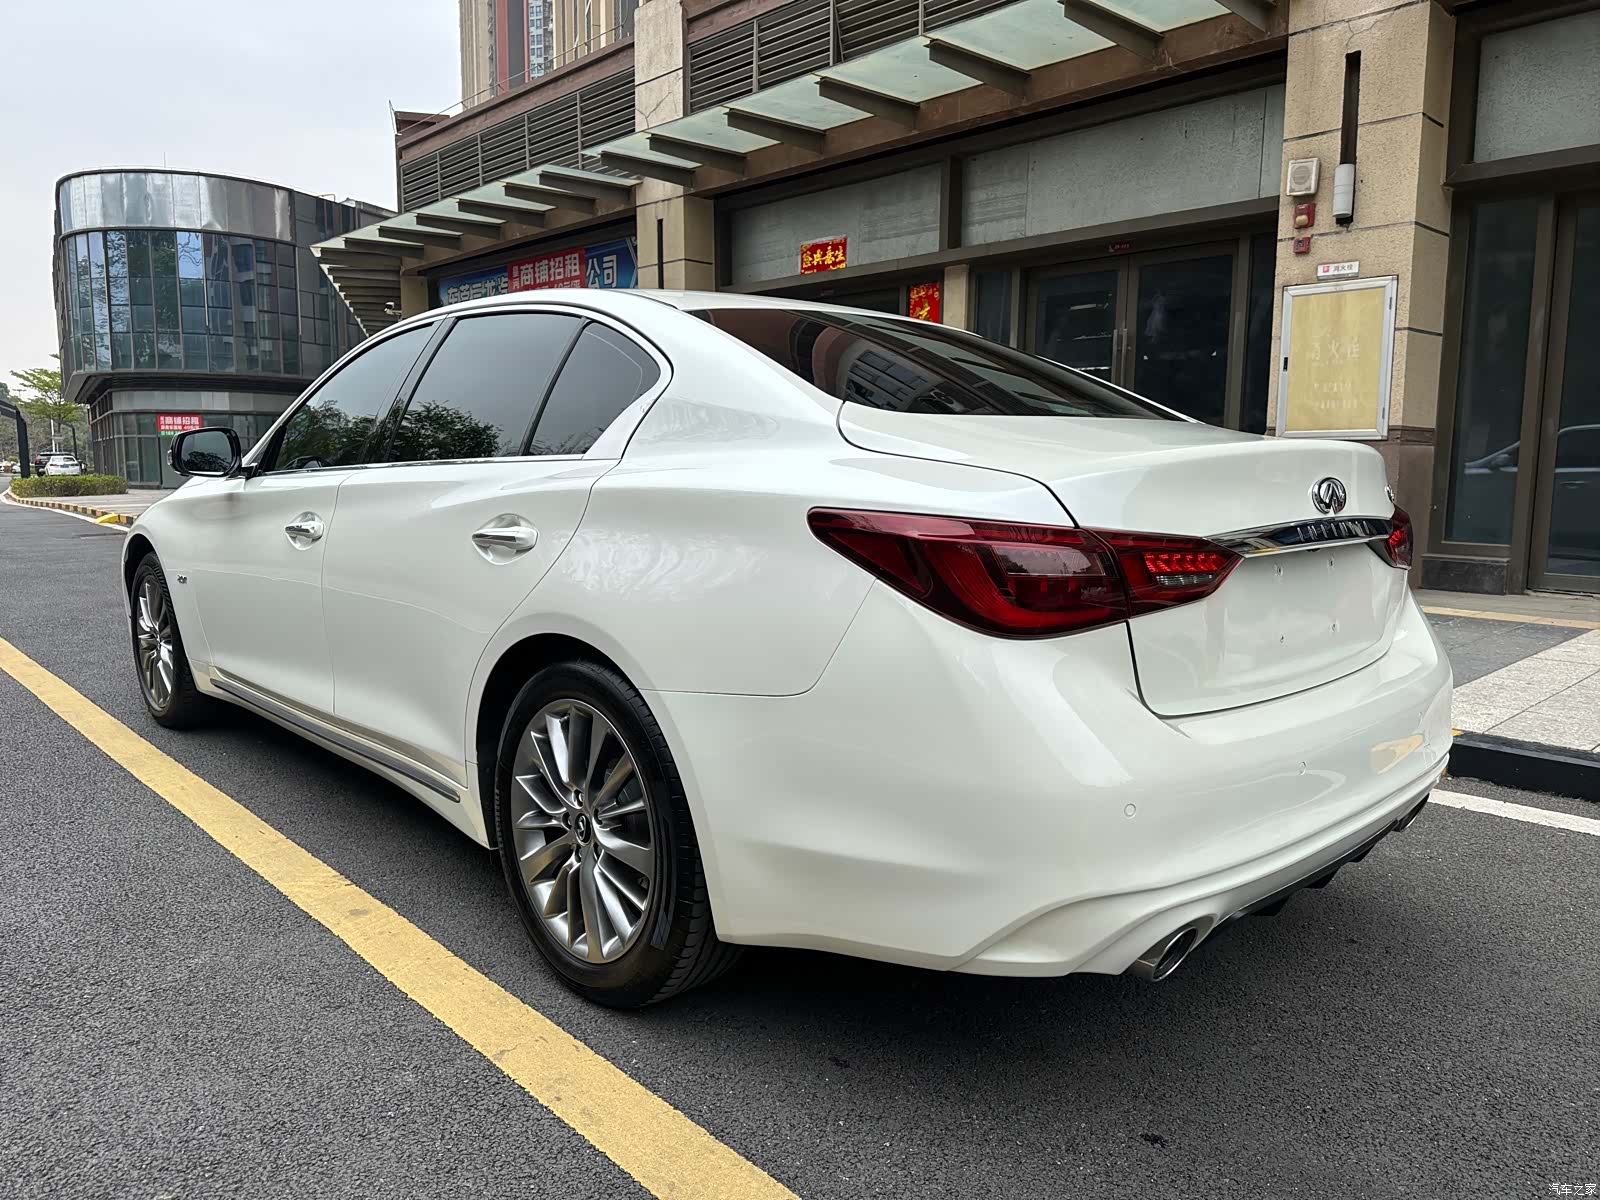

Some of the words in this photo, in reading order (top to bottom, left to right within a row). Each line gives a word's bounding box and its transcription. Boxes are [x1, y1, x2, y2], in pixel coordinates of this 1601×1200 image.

[519, 253, 580, 287] 商铺招租
[586, 254, 618, 288] 公司
[1332, 264, 1354, 272] 消火栓
